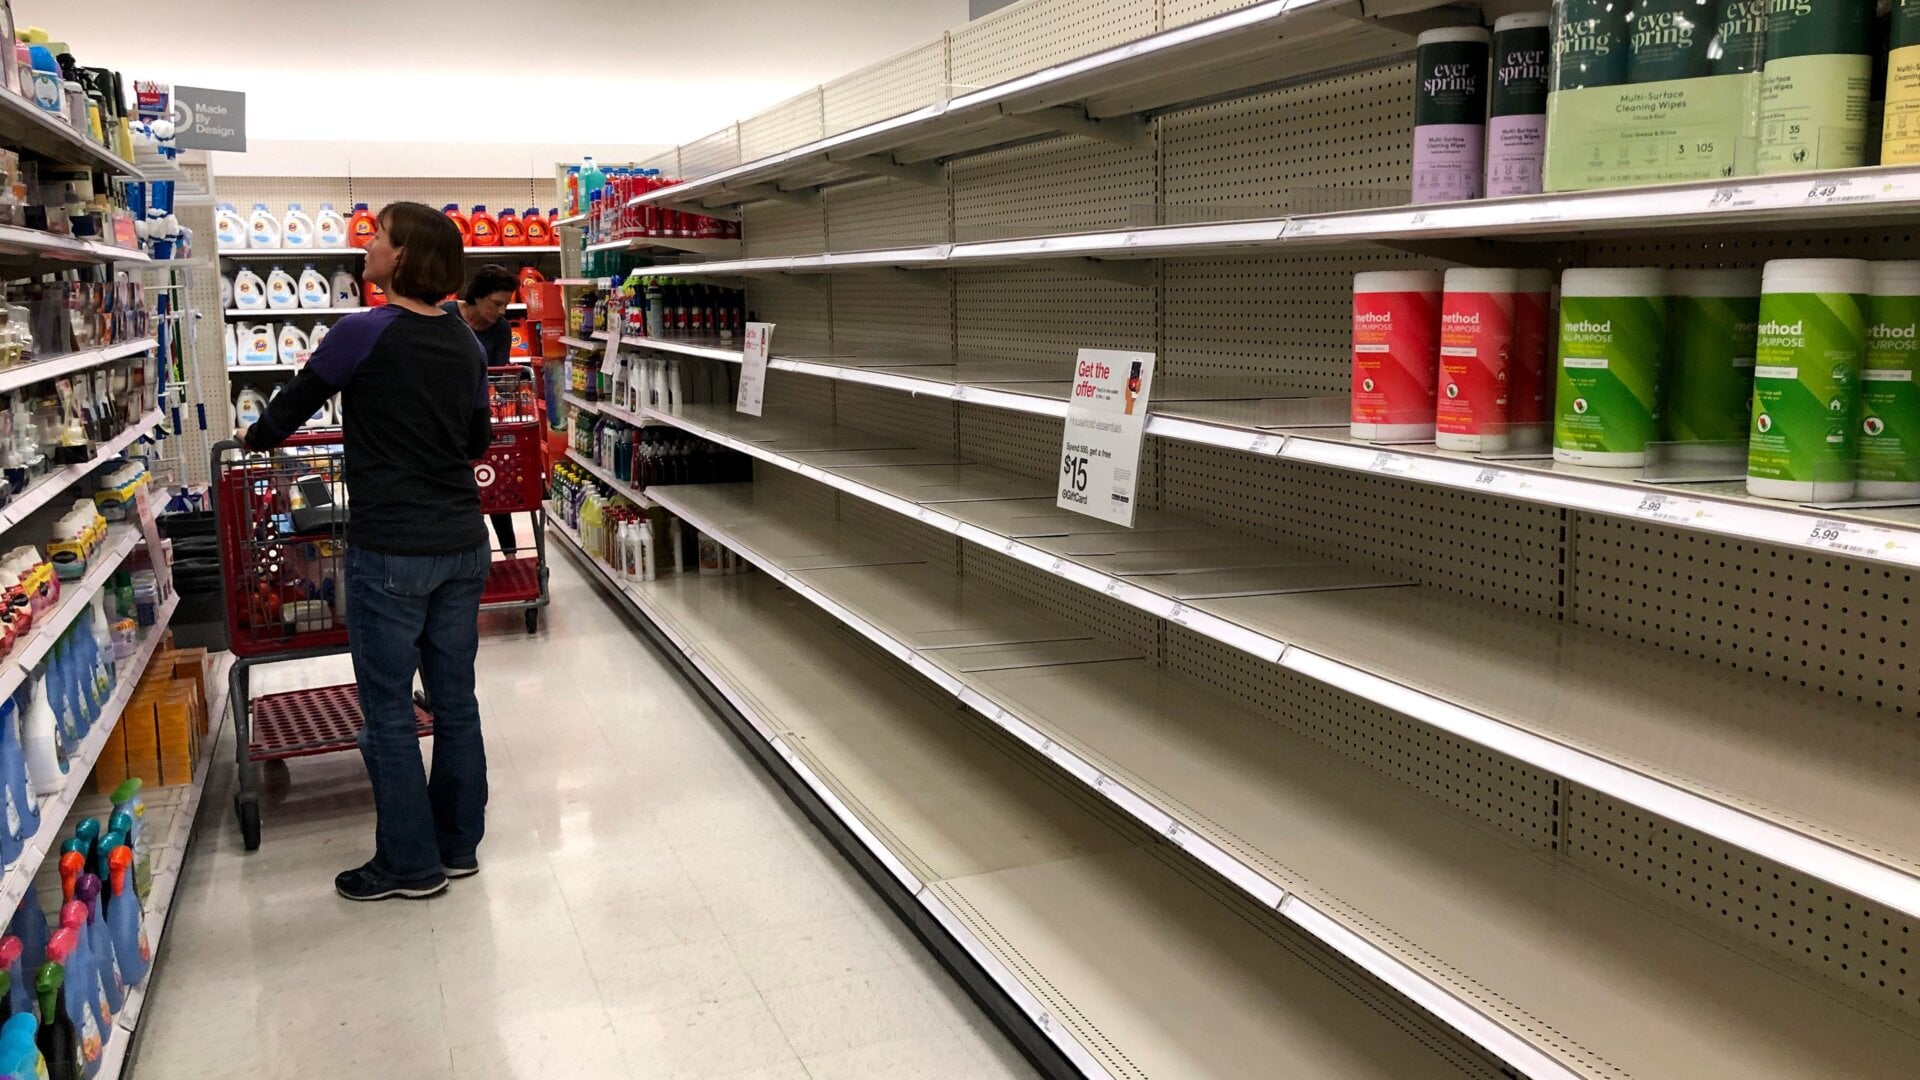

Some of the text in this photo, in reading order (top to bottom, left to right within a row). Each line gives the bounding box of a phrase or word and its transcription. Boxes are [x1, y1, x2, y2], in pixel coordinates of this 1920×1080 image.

[1727, 0, 1765, 19] eve
[1638, 10, 1684, 31] ever
[1717, 13, 1769, 43] sprin
[1560, 19, 1601, 38] ever
[1552, 32, 1611, 56] spring
[1631, 25, 1693, 54] spring
[1507, 50, 1544, 65] ever
[1434, 63, 1469, 77] ever
[1498, 63, 1549, 86] spring
[1424, 75, 1475, 96] spring
[1620, 91, 1684, 103] Multi-Surface
[195, 103, 228, 115] Made
[1615, 100, 1687, 113] Cleaning Wipes
[195, 113, 211, 125] By
[195, 123, 235, 138] Design
[1789, 125, 1800, 135] 35
[1678, 142, 1714, 154] 3 105
[1808, 186, 1836, 198] 6.49
[1565, 319, 1610, 333] method
[1864, 323, 1915, 338] thod
[1078, 360, 1110, 380] Get the
[1075, 380, 1097, 398] offer
[1070, 416, 1122, 434] Household essentials
[1066, 442, 1080, 452] Spend
[1089, 448, 1098, 457] get
[1102, 449, 1112, 459] free
[1063, 453, 1088, 492] $15
[1476, 474, 1494, 484] 5.99
[1066, 490, 1088, 505] GiftCard
[1639, 500, 1661, 512] 2.99
[1810, 527, 1840, 541] 5.99
